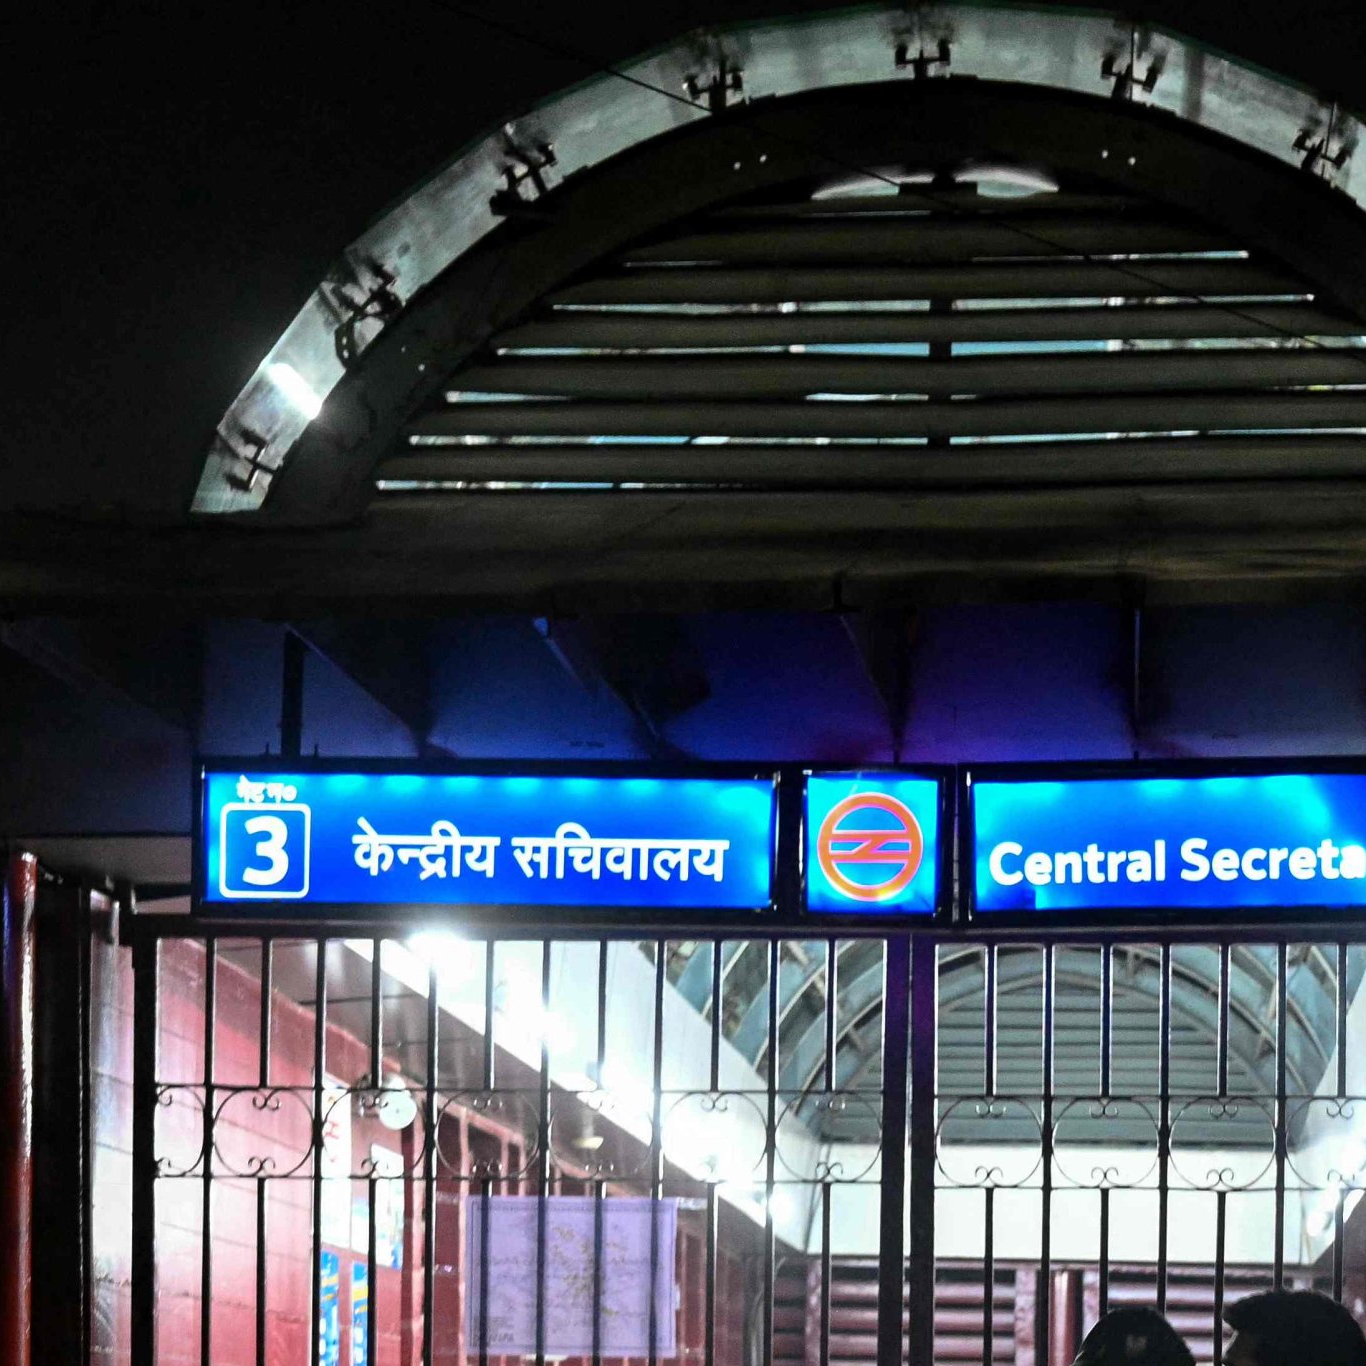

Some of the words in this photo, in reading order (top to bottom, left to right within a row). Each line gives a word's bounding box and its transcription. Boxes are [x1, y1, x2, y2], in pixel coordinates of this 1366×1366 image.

[242, 815, 289, 886] 3
[352, 816, 500, 881] केन्द्रीय
[511, 822, 730, 882] सचिवालय
[989, 839, 1166, 886] Central
